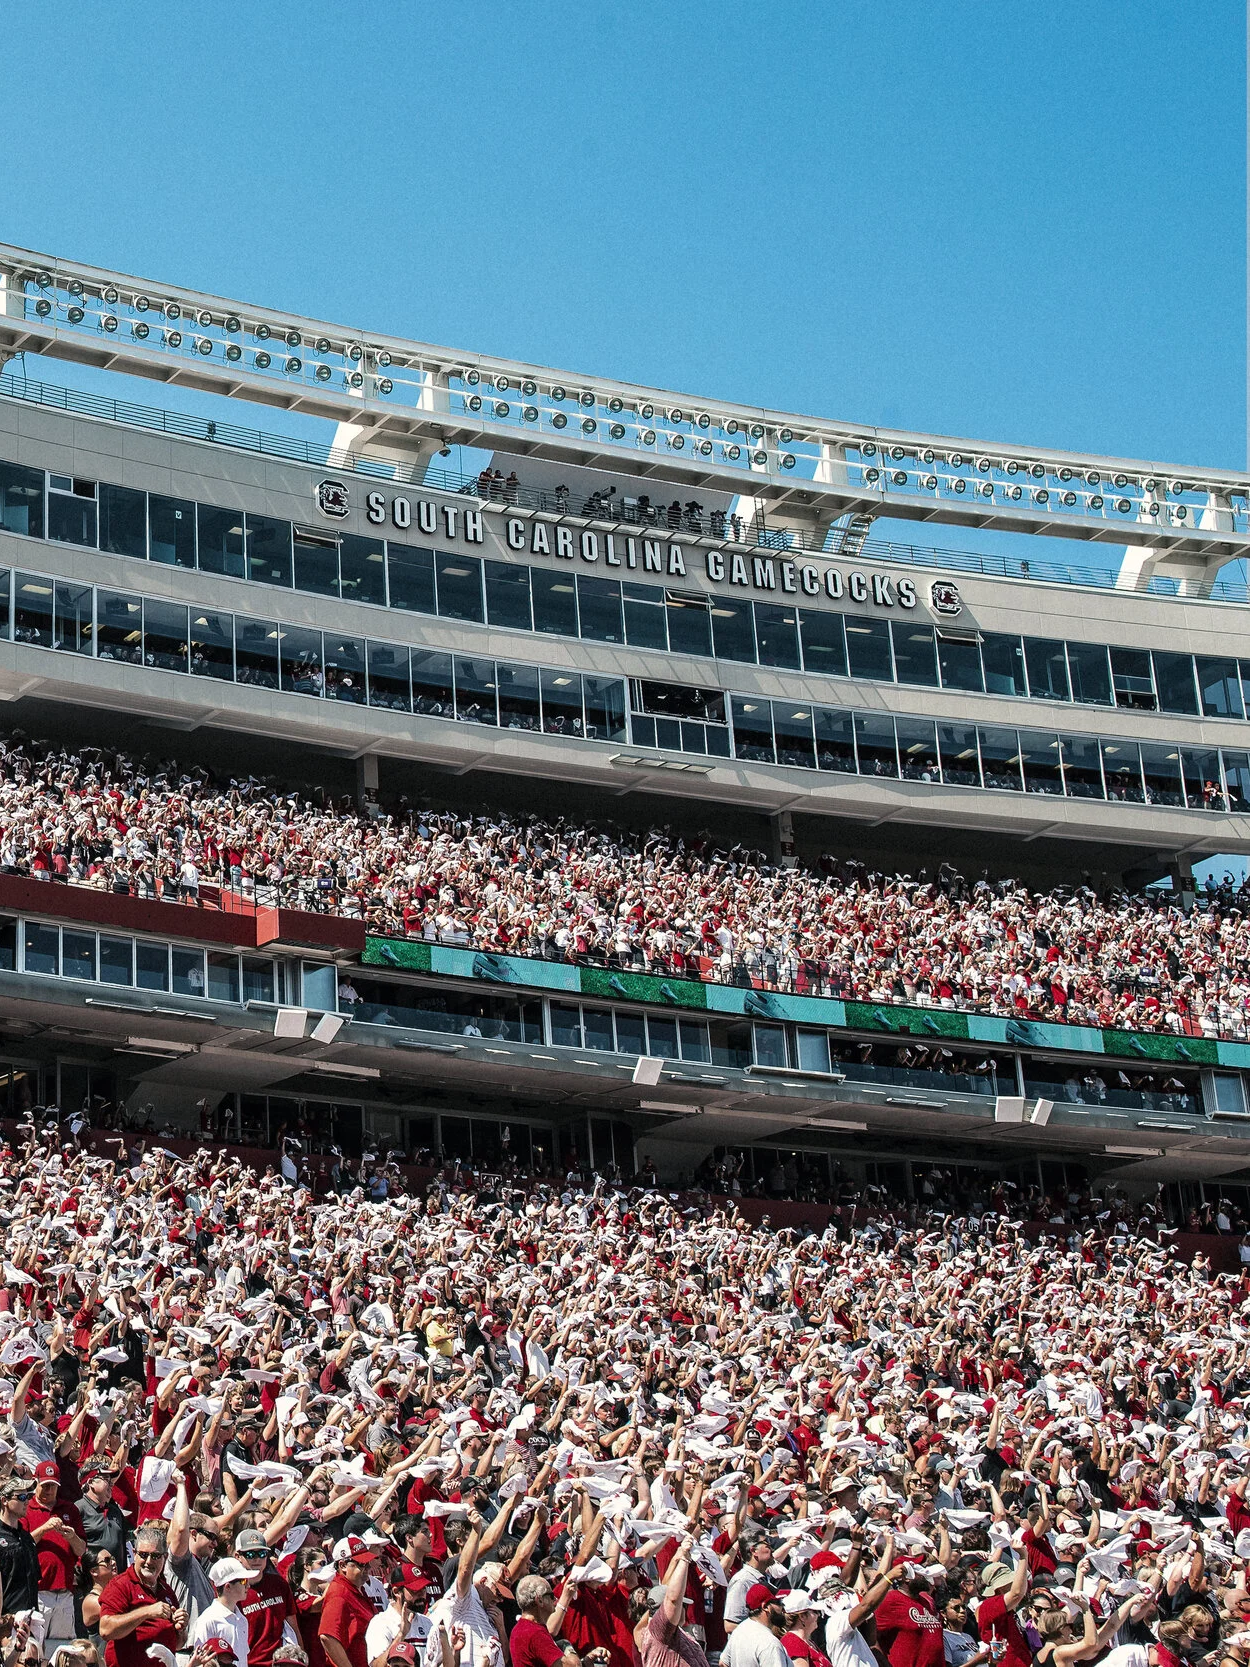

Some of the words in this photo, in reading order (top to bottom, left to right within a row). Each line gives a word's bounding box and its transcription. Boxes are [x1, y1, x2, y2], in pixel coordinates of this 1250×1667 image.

[366, 491, 484, 544] SOUTH
[506, 518, 687, 577] CAROLINA
[705, 550, 916, 609] GAMECOCKS
[242, 1602, 261, 1616] SOUTH
